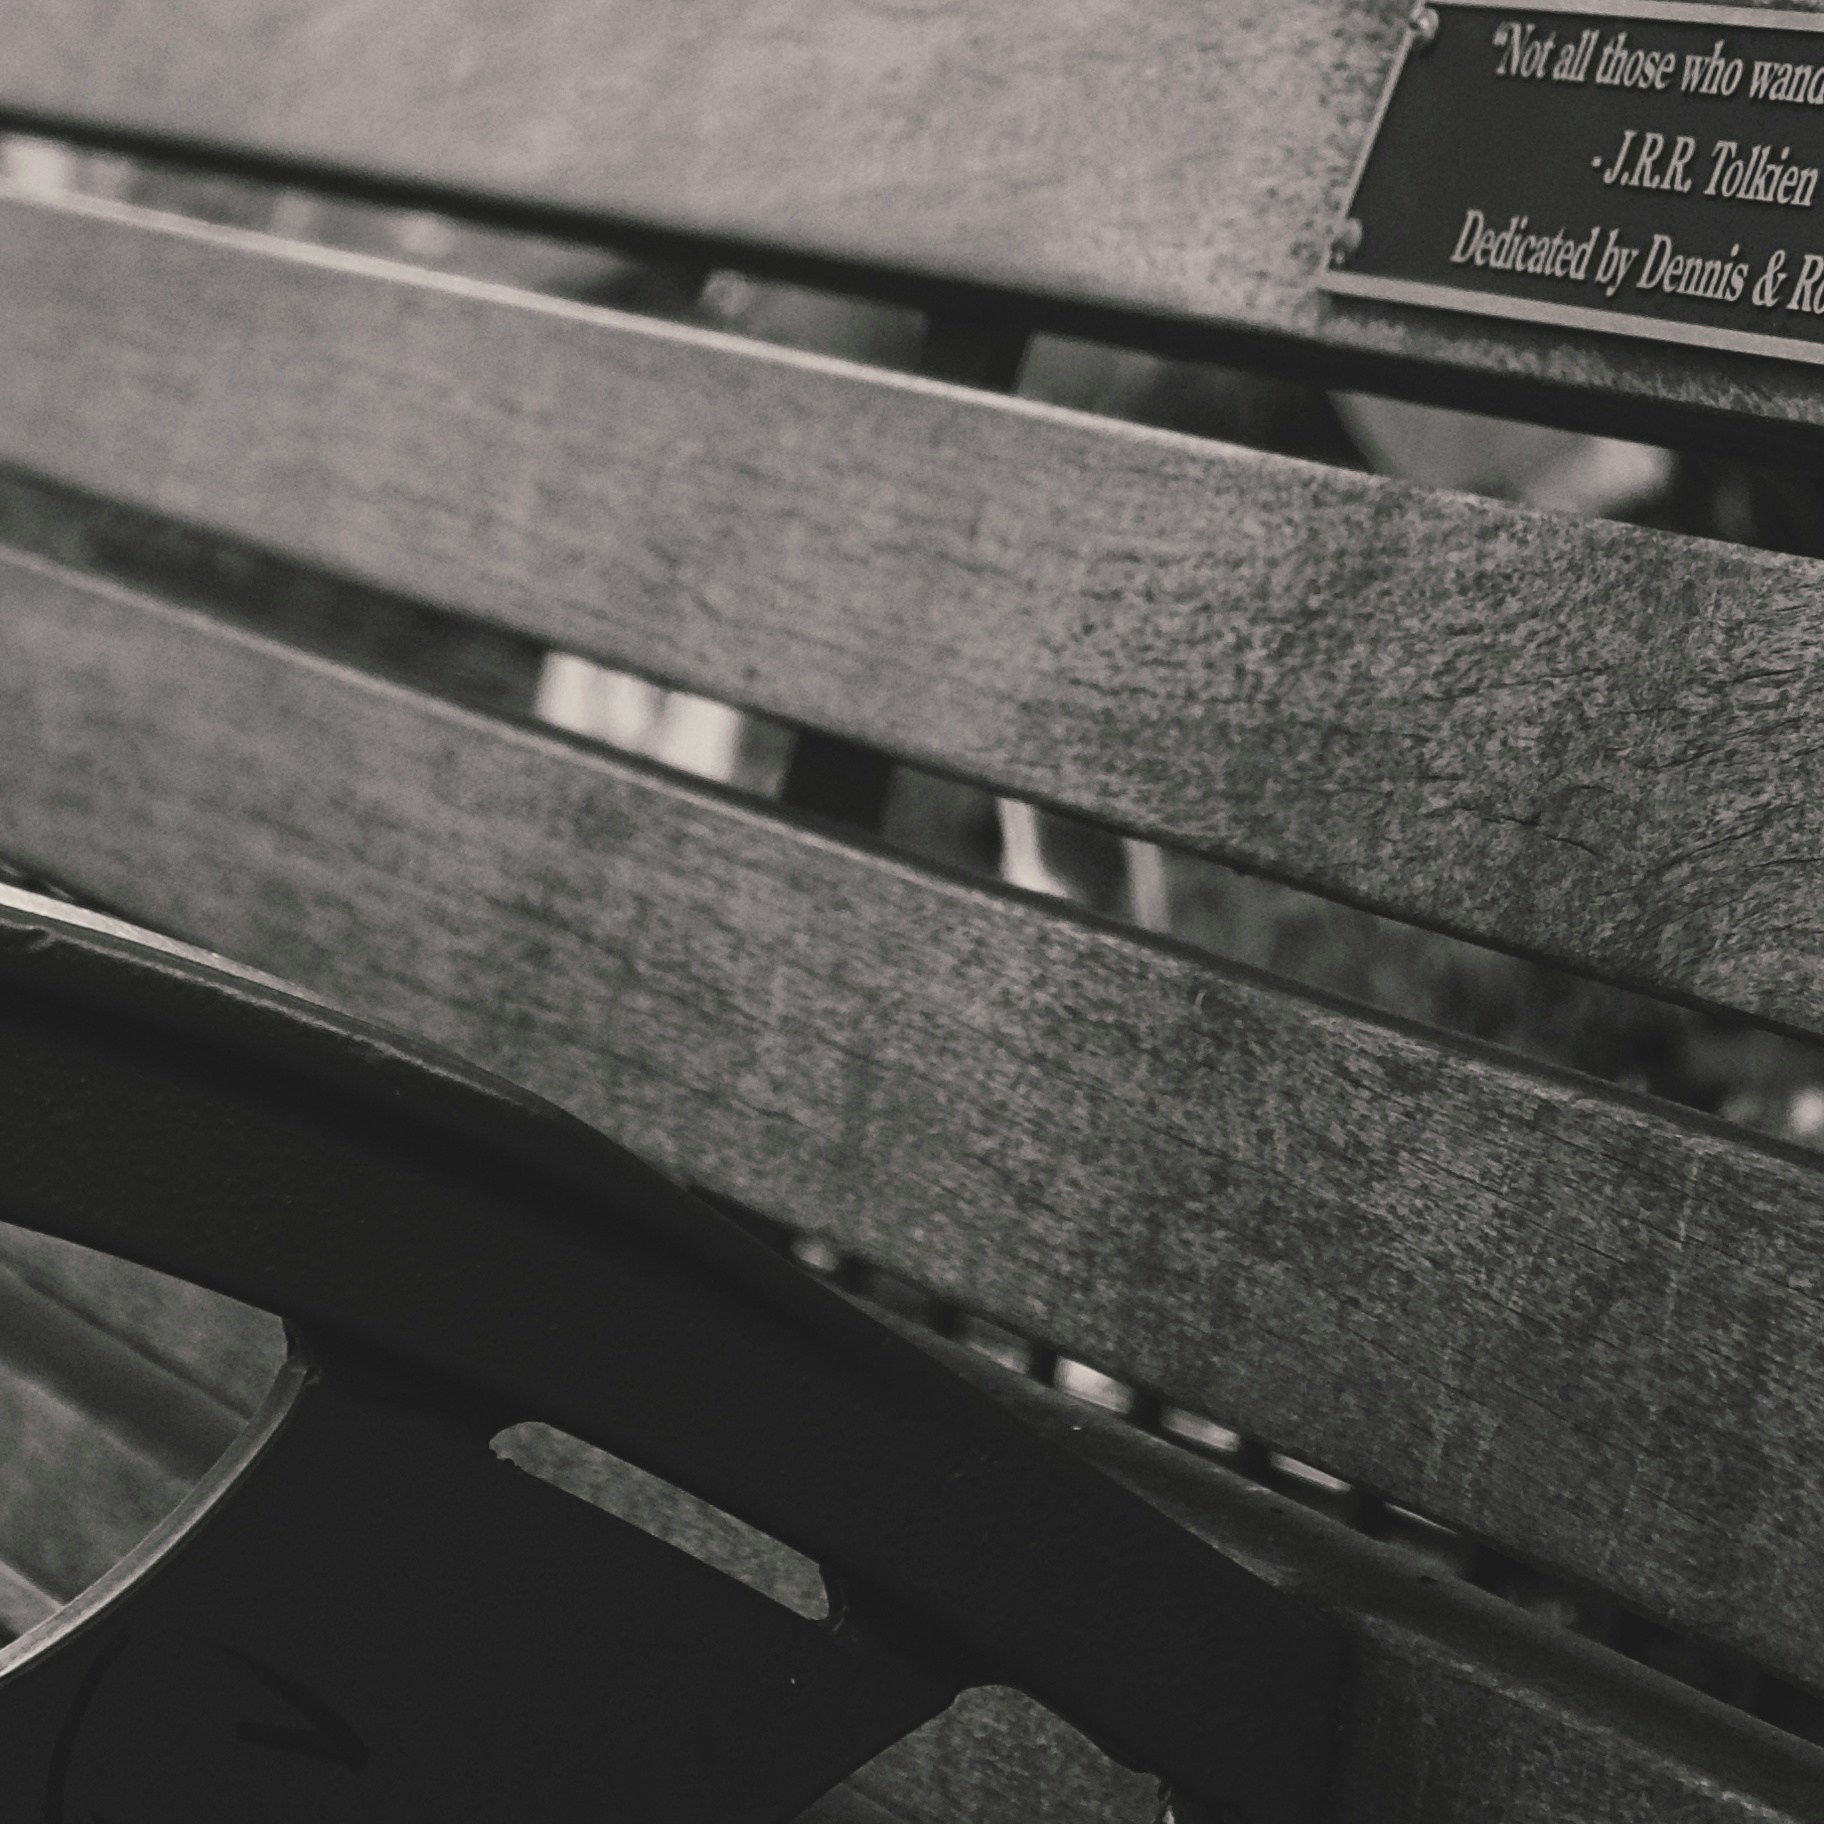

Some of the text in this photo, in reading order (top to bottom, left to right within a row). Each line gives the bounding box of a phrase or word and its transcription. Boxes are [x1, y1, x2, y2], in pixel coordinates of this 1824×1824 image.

[1552, 29, 1600, 82] all
[1595, 32, 1676, 89] those
[1680, 40, 1744, 95] who
[1703, 140, 1819, 206] Tolkien
[1450, 208, 1601, 280] Dedicated
[1594, 228, 1640, 297] by
[1636, 233, 1749, 301] Dennis
[1752, 249, 1788, 307] &
